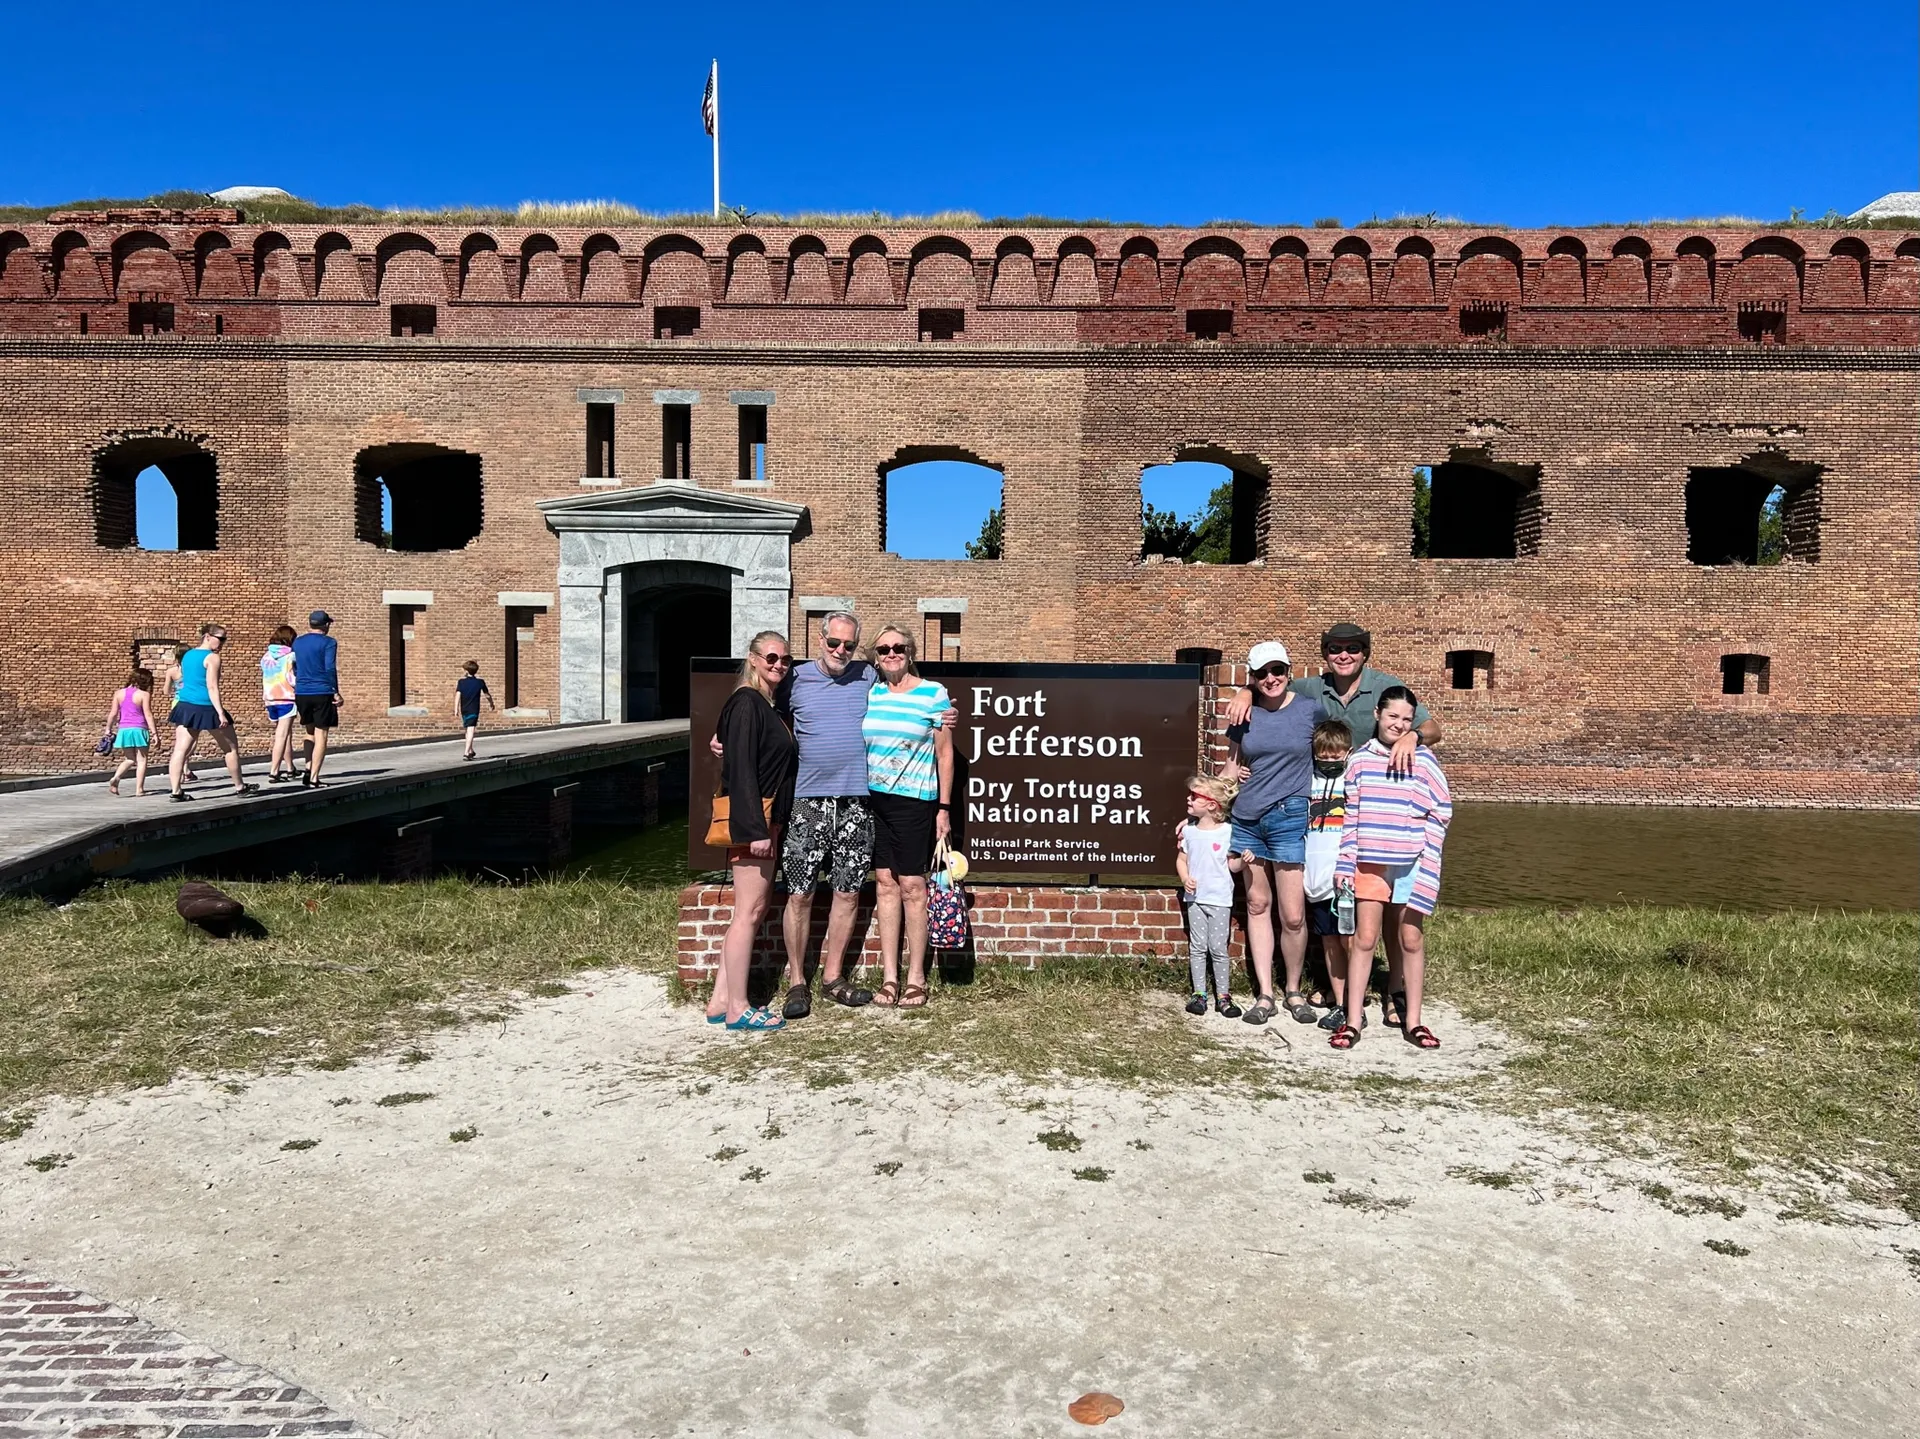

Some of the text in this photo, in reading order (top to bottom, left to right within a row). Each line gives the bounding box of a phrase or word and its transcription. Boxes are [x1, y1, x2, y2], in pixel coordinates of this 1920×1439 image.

[971, 687, 1046, 716] Fort
[969, 726, 1143, 763] Jefferson
[969, 778, 1142, 804] Dry Tortugas
[969, 803, 1150, 824] National Park
[970, 837, 1100, 849] National Park Service
[970, 850, 1156, 863] U.S. Department of the Interior
